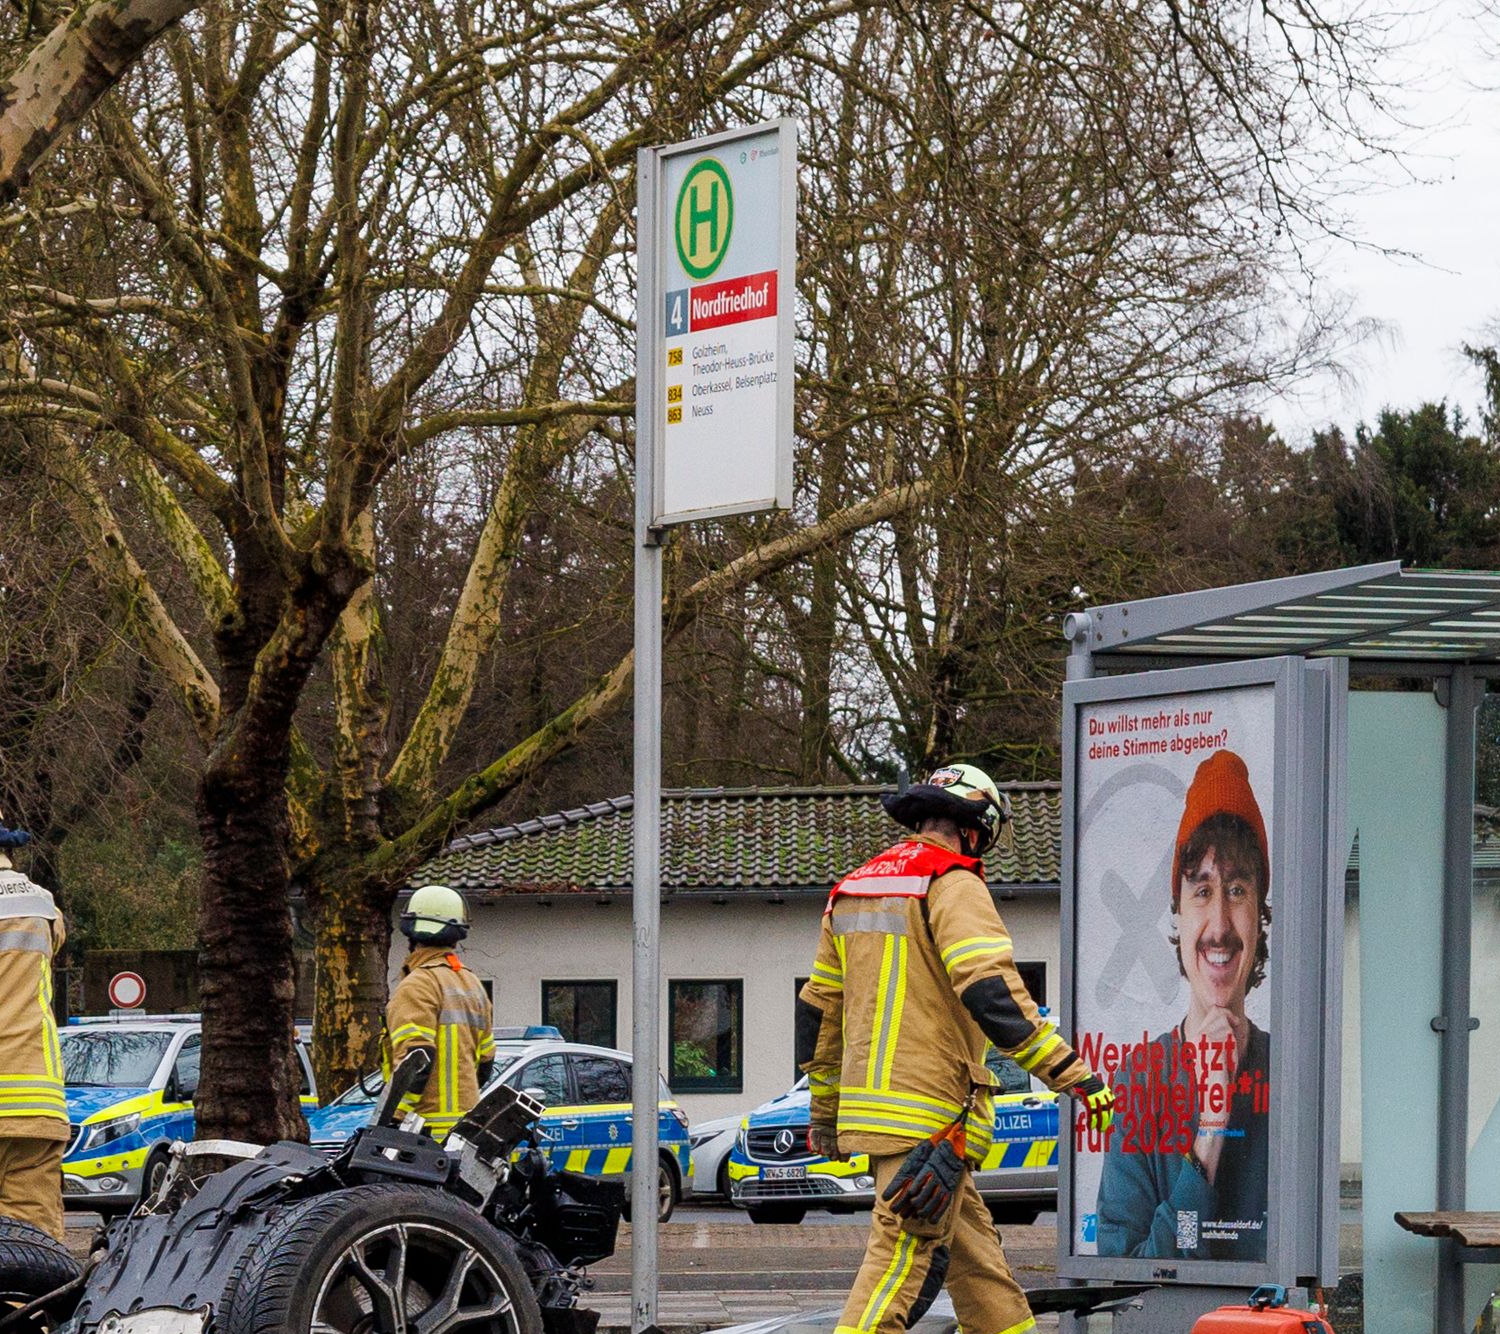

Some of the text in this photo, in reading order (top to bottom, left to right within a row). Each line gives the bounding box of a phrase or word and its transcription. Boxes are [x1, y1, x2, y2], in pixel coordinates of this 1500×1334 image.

[671, 282, 769, 330] 4 Nordfriedhof
[668, 342, 728, 364] 758 Golzheim,
[692, 351, 774, 376] Theodor-Heuss-Brücke
[667, 388, 682, 401] 834
[692, 378, 733, 397] Oberkassel,
[667, 404, 714, 422] 863 Neuss
[1089, 709, 1213, 736] Du willst mehr als nur
[1089, 729, 1228, 760] deine Stimme abgeben?
[1075, 1027, 1236, 1083] Werde jetzt
[994, 1114, 1032, 1131] OLIZEI
[1121, 1111, 1194, 1154] 2025
